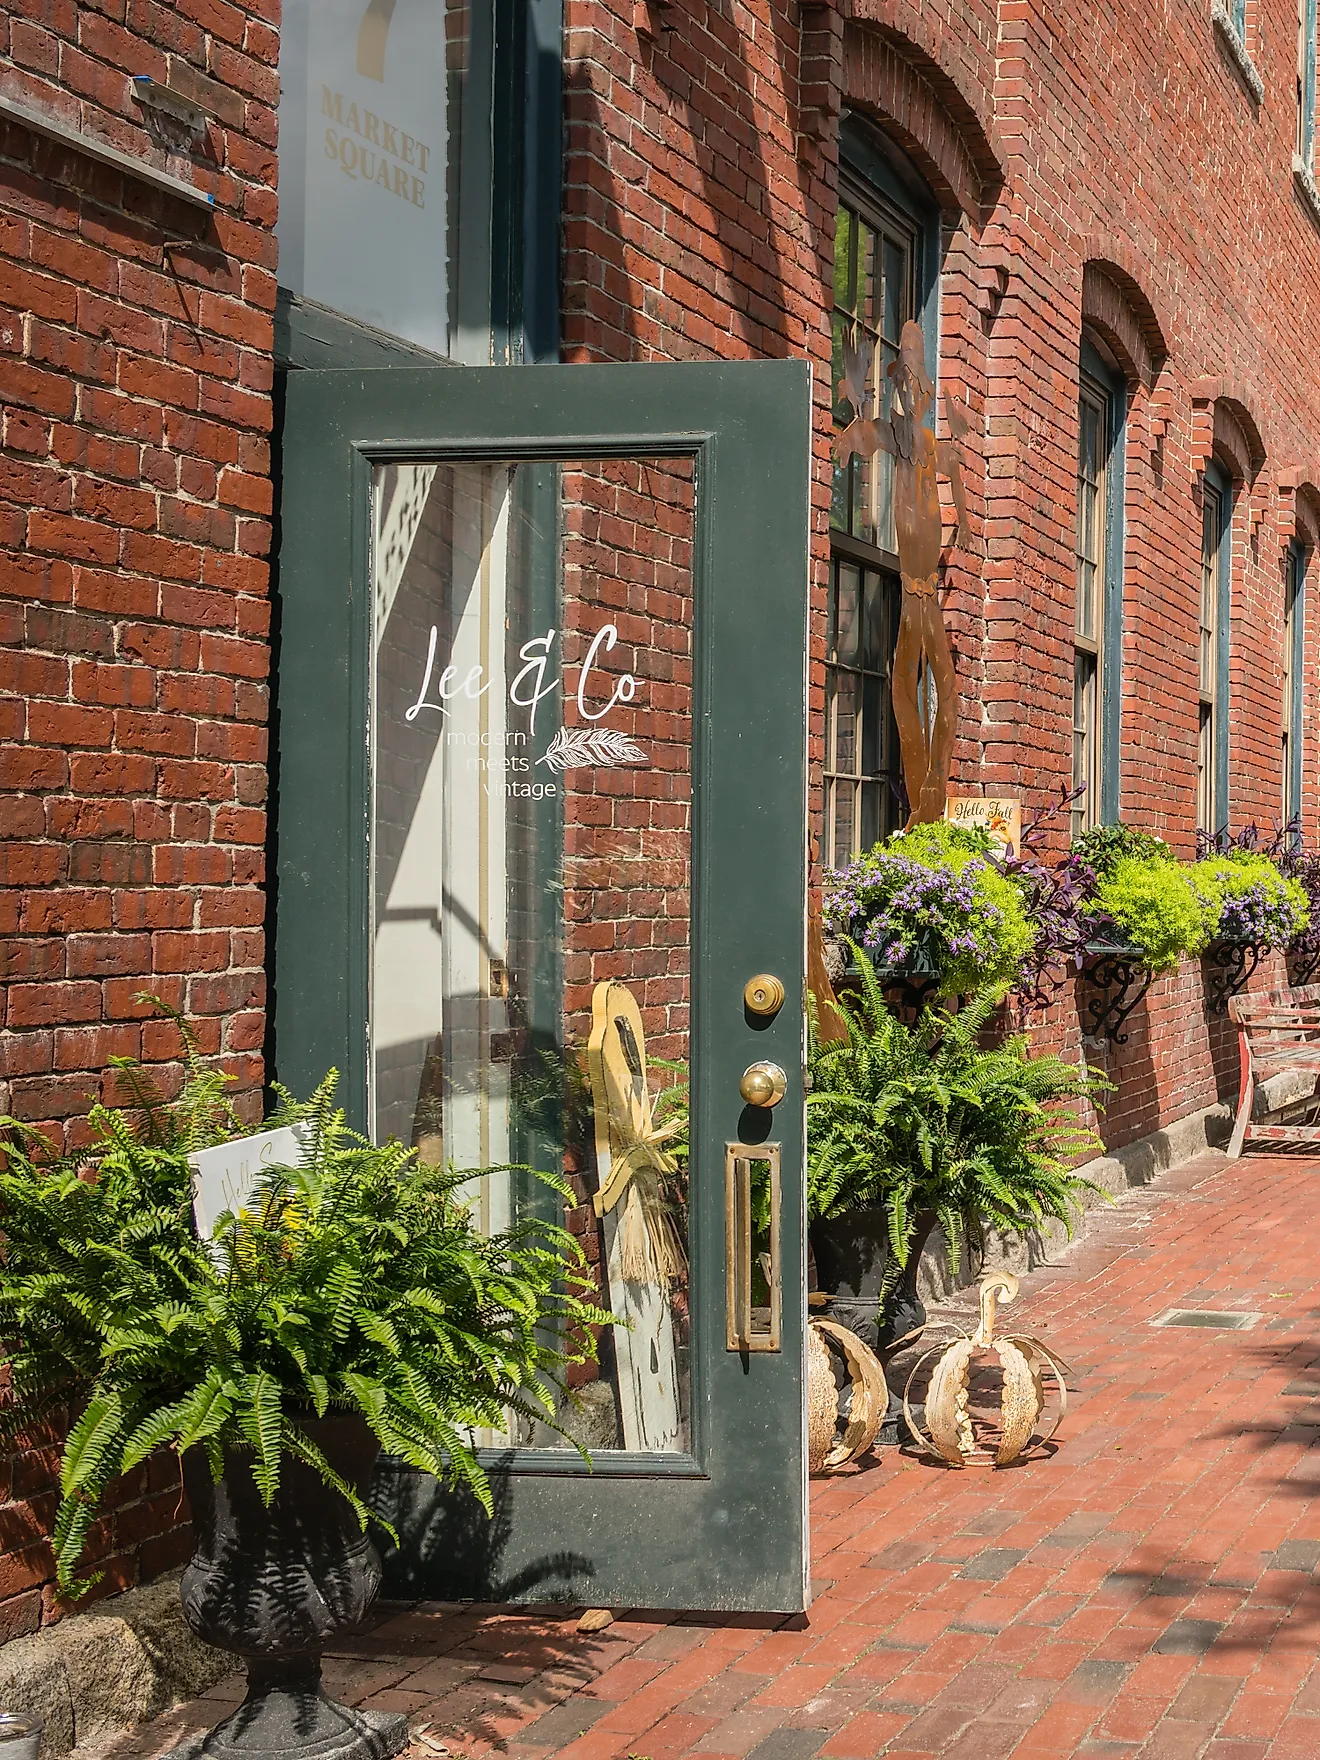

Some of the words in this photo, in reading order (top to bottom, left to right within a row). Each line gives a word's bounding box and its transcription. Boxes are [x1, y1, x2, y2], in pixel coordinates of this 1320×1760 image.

[320, 84, 430, 174] MARKET
[324, 127, 425, 210] SQUARE
[405, 625, 494, 721] Lee
[510, 628, 559, 736] &
[577, 624, 645, 720] Co
[447, 729, 527, 746] modern
[466, 756, 530, 771] meets
[483, 780, 557, 800] vintage
[954, 800, 984, 820] Hello
[987, 800, 1013, 820] Fall
